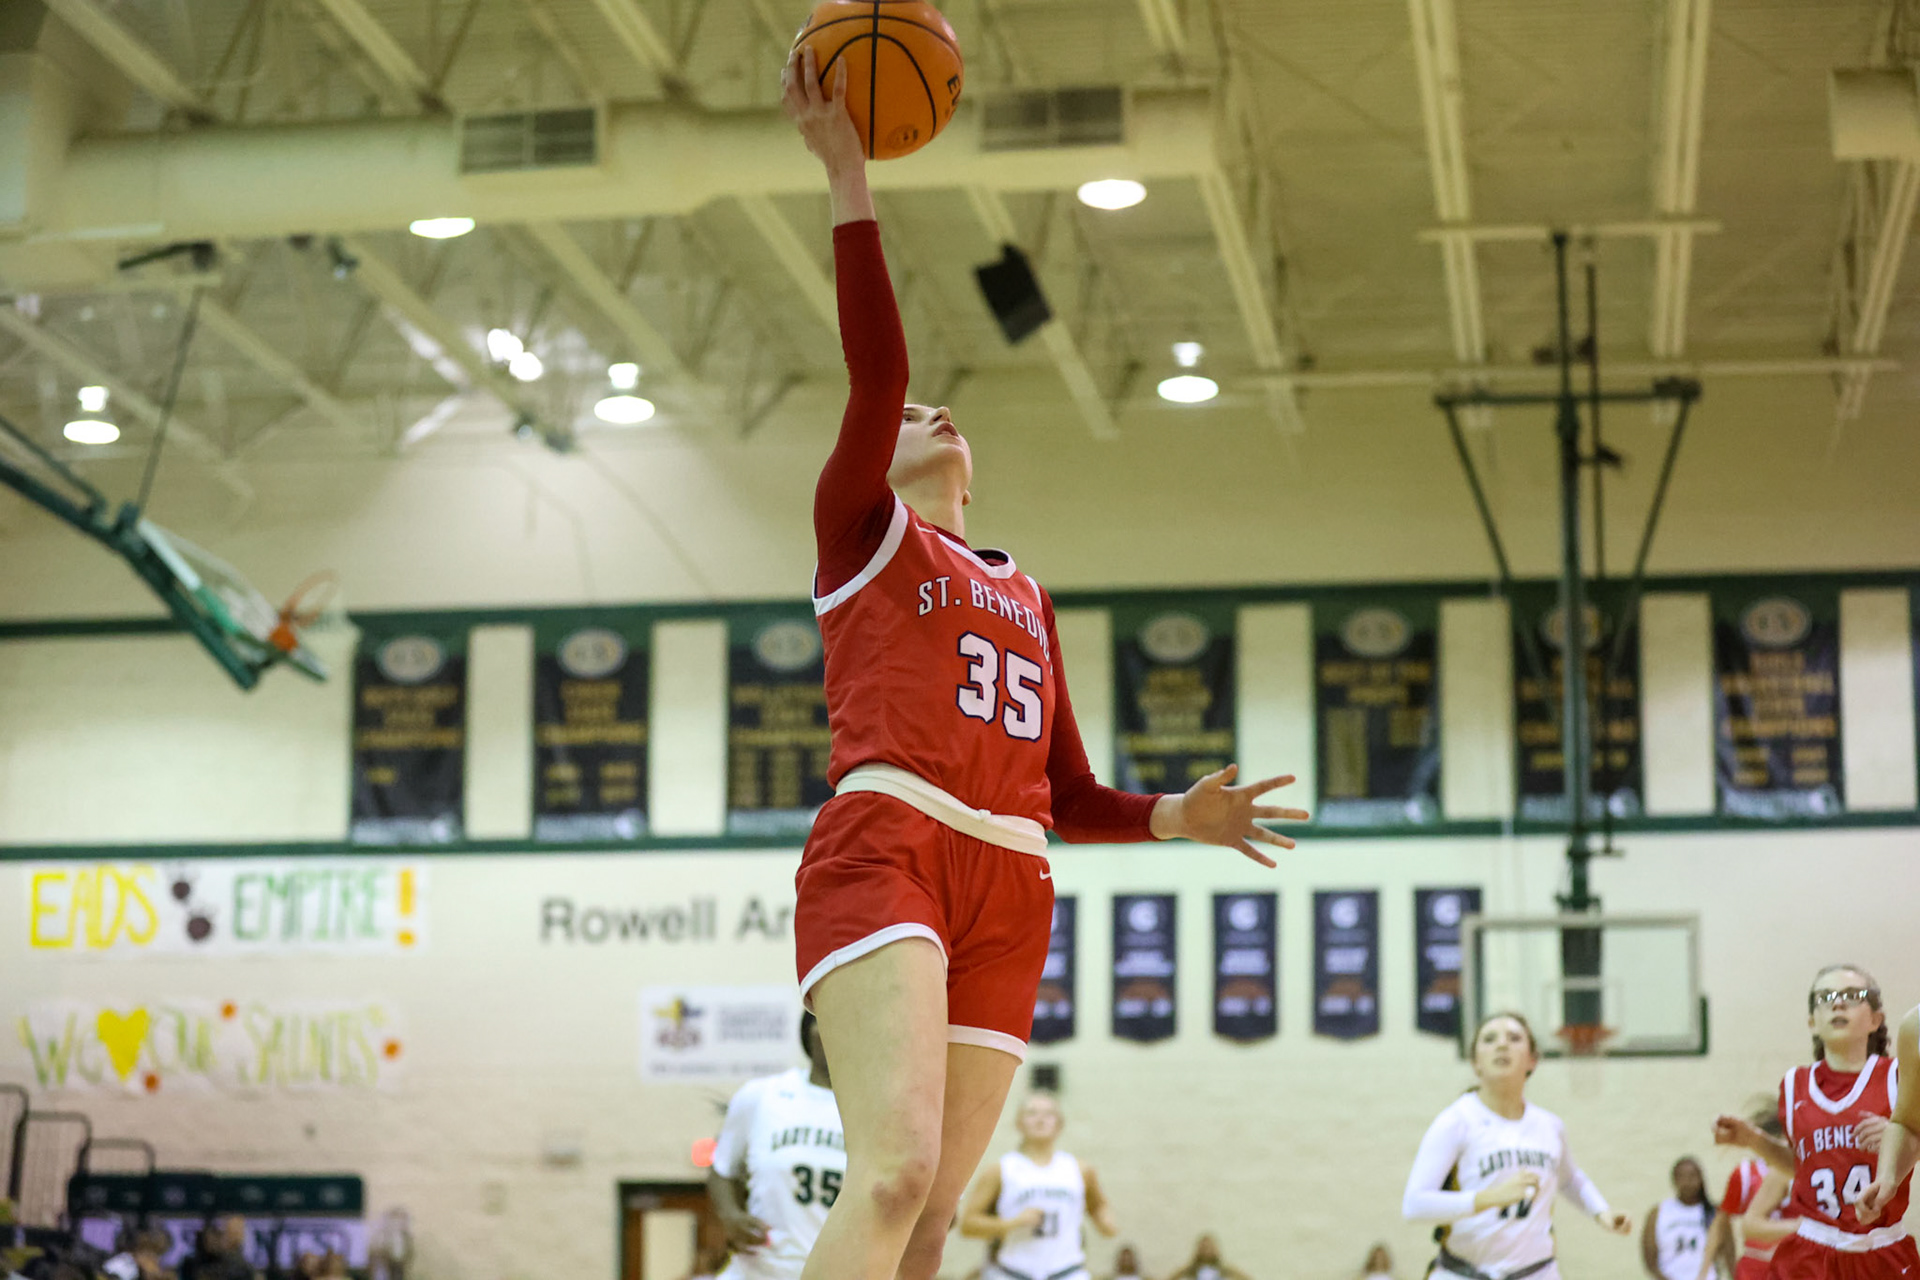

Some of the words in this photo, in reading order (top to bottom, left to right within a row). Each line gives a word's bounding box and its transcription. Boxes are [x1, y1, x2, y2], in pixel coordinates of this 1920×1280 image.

[918, 576, 961, 616] ST.
[969, 578, 1053, 676] BENEDIC
[956, 630, 1043, 743] 35
[30, 865, 159, 948] EADS
[541, 897, 717, 944] Rowell
[736, 897, 797, 943] Ar
[792, 1163, 845, 1210] 35
[1810, 1164, 1872, 1220] 34
